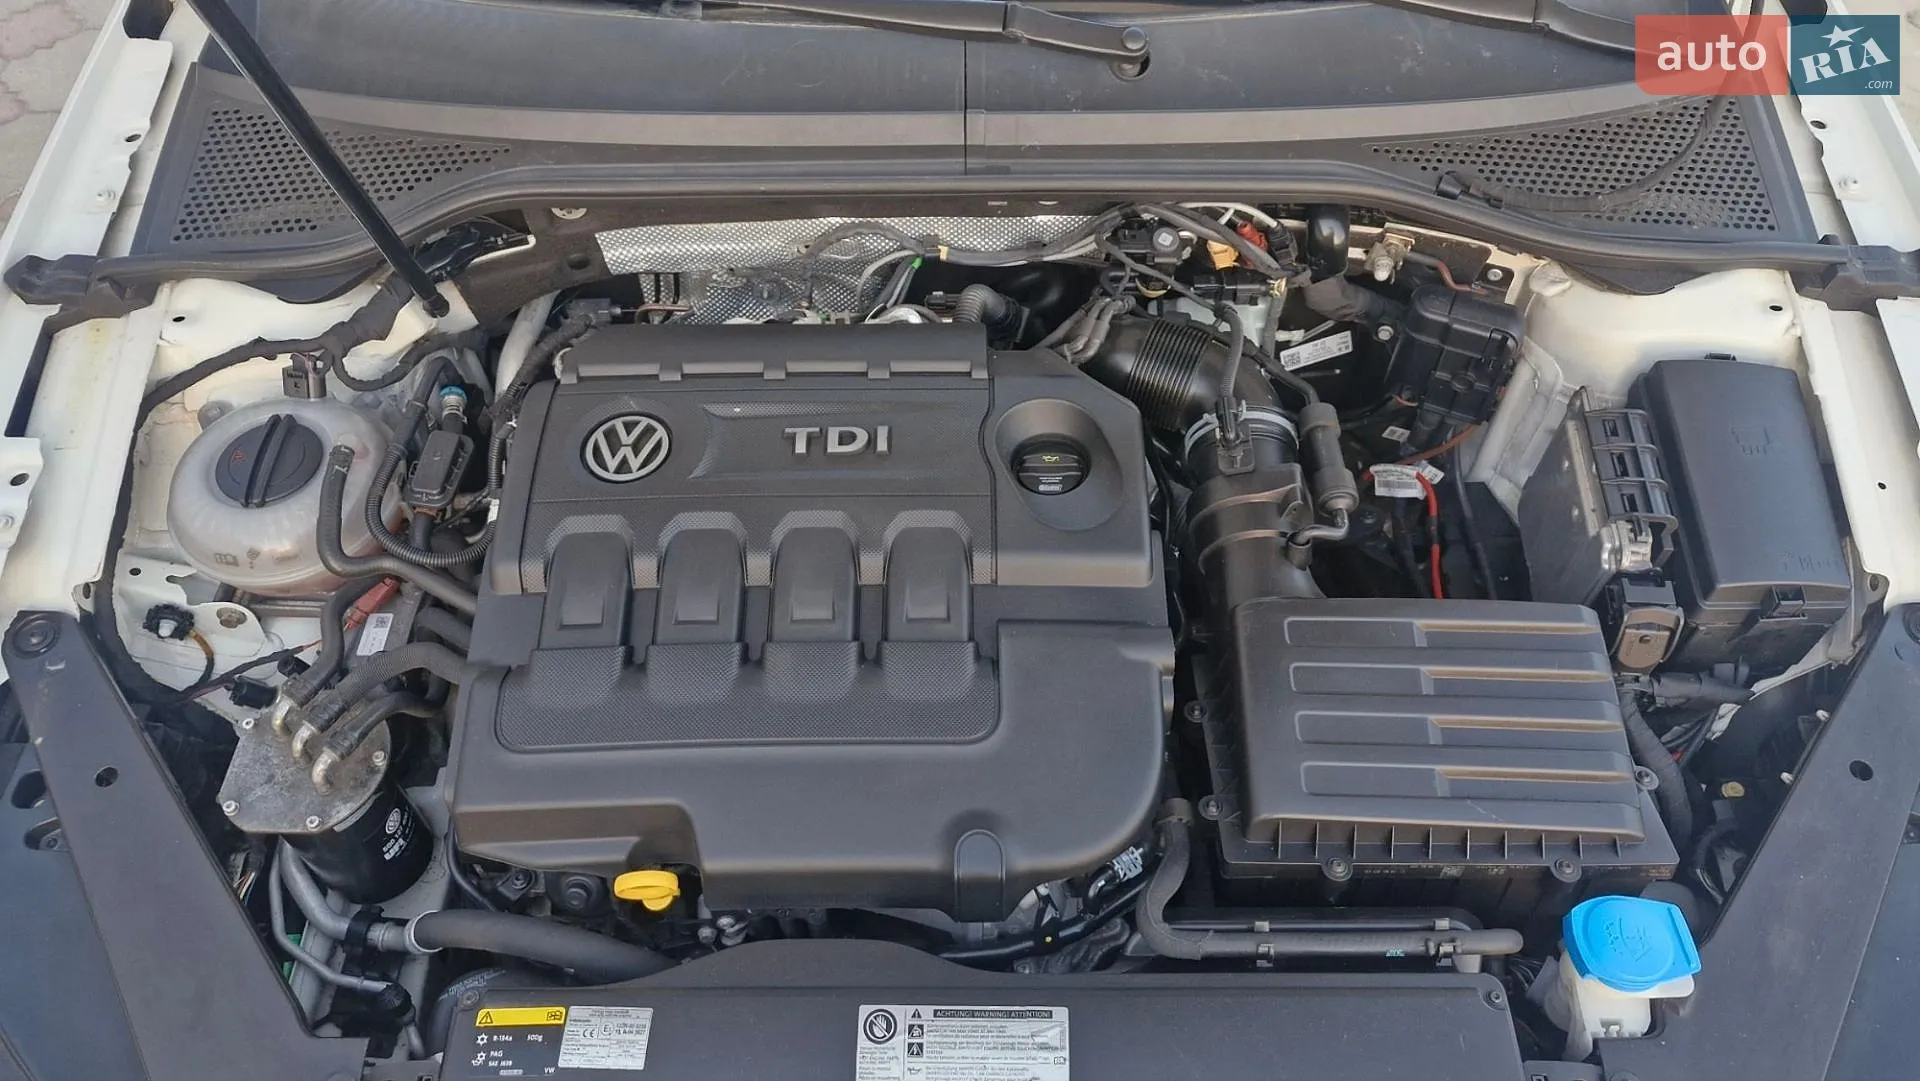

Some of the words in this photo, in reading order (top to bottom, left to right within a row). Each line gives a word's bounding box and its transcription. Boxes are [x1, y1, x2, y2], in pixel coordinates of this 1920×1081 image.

[784, 426, 888, 455] TDI
[936, 1009, 972, 1017] ACHTUNG!
[973, 1010, 1009, 1018] WARNING!
[1011, 1010, 1052, 1019] ATTENTION!
